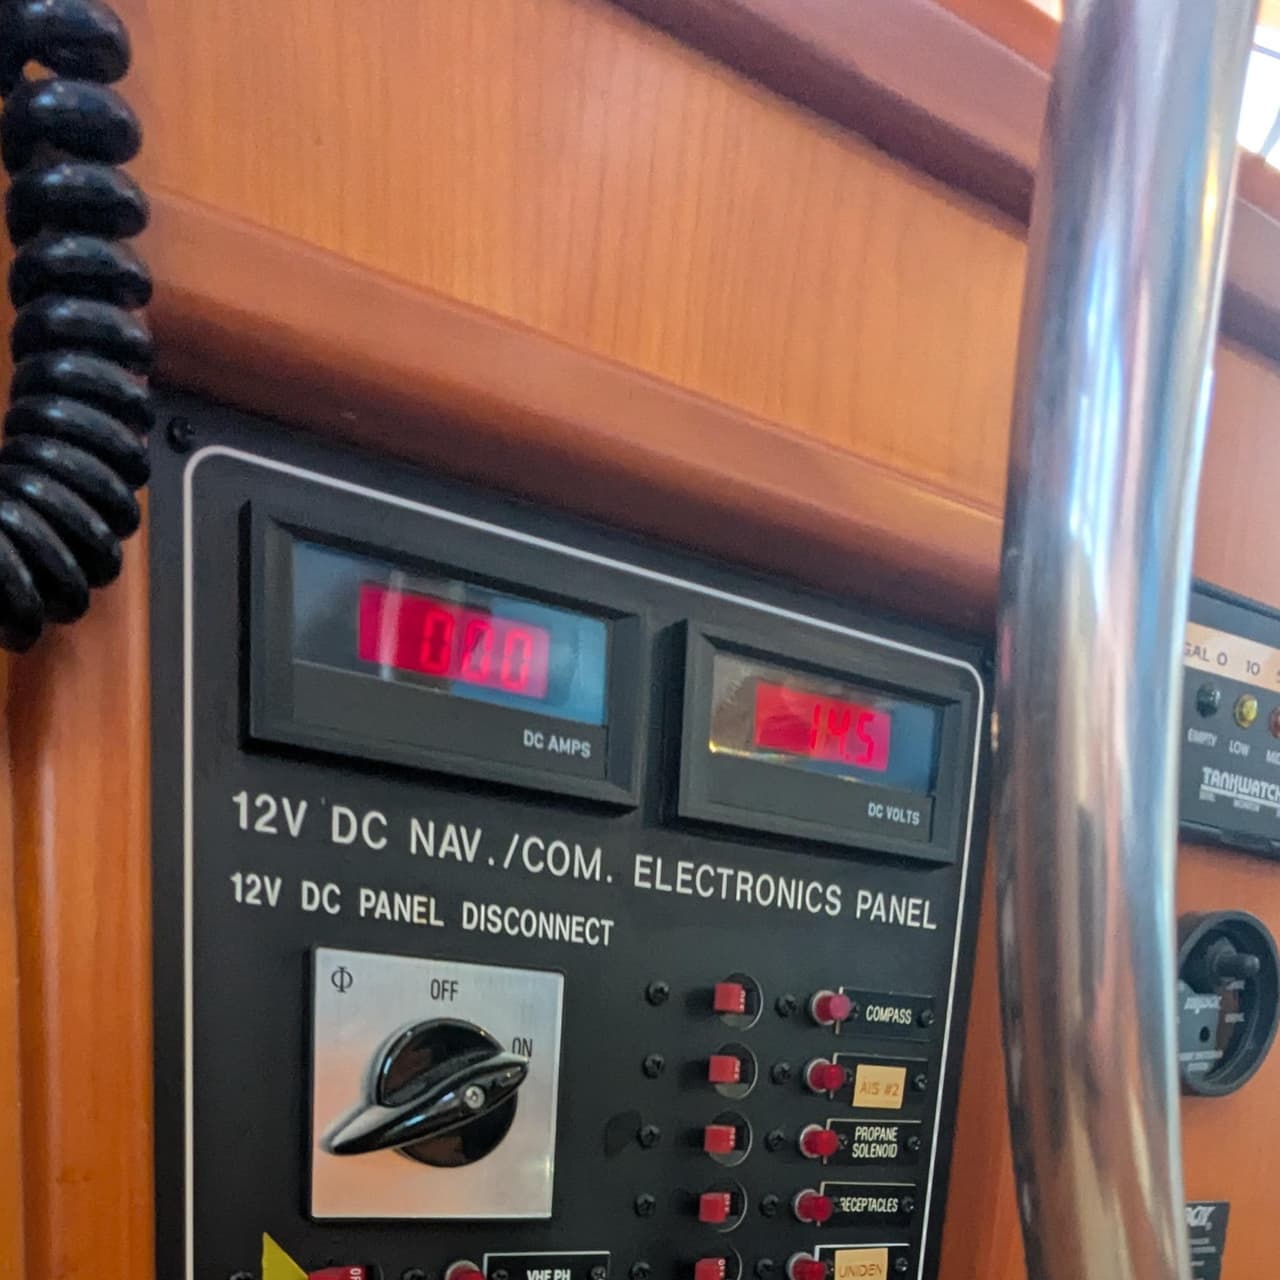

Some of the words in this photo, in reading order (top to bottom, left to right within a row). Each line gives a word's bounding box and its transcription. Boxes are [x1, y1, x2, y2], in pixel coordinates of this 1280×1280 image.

[1246, 660, 1260, 676] 10
[523, 729, 545, 750] DC
[548, 737, 591, 758] AMPS
[1229, 740, 1250, 757] LOW
[867, 802, 883, 818] DC
[886, 805, 921, 826] VOLTS
[232, 791, 307, 838] 12V
[331, 805, 388, 850] DC
[634, 854, 843, 917] ELECTRONICS
[855, 889, 938, 930] PANEL
[230, 872, 282, 907] 12V
[301, 880, 341, 914] DC
[359, 888, 445, 927] PANEL
[463, 901, 615, 946] DISCONNECT
[430, 978, 459, 1002] OFF
[865, 1005, 912, 1025] COMPASS
[512, 1036, 533, 1058] ON
[859, 1078, 879, 1096] AIS
[883, 1081, 901, 1098] #2
[855, 1126, 899, 1142] PROPANE
[852, 1142, 898, 1159] SOLENOID
[839, 1263, 884, 1278] UNIDEN
